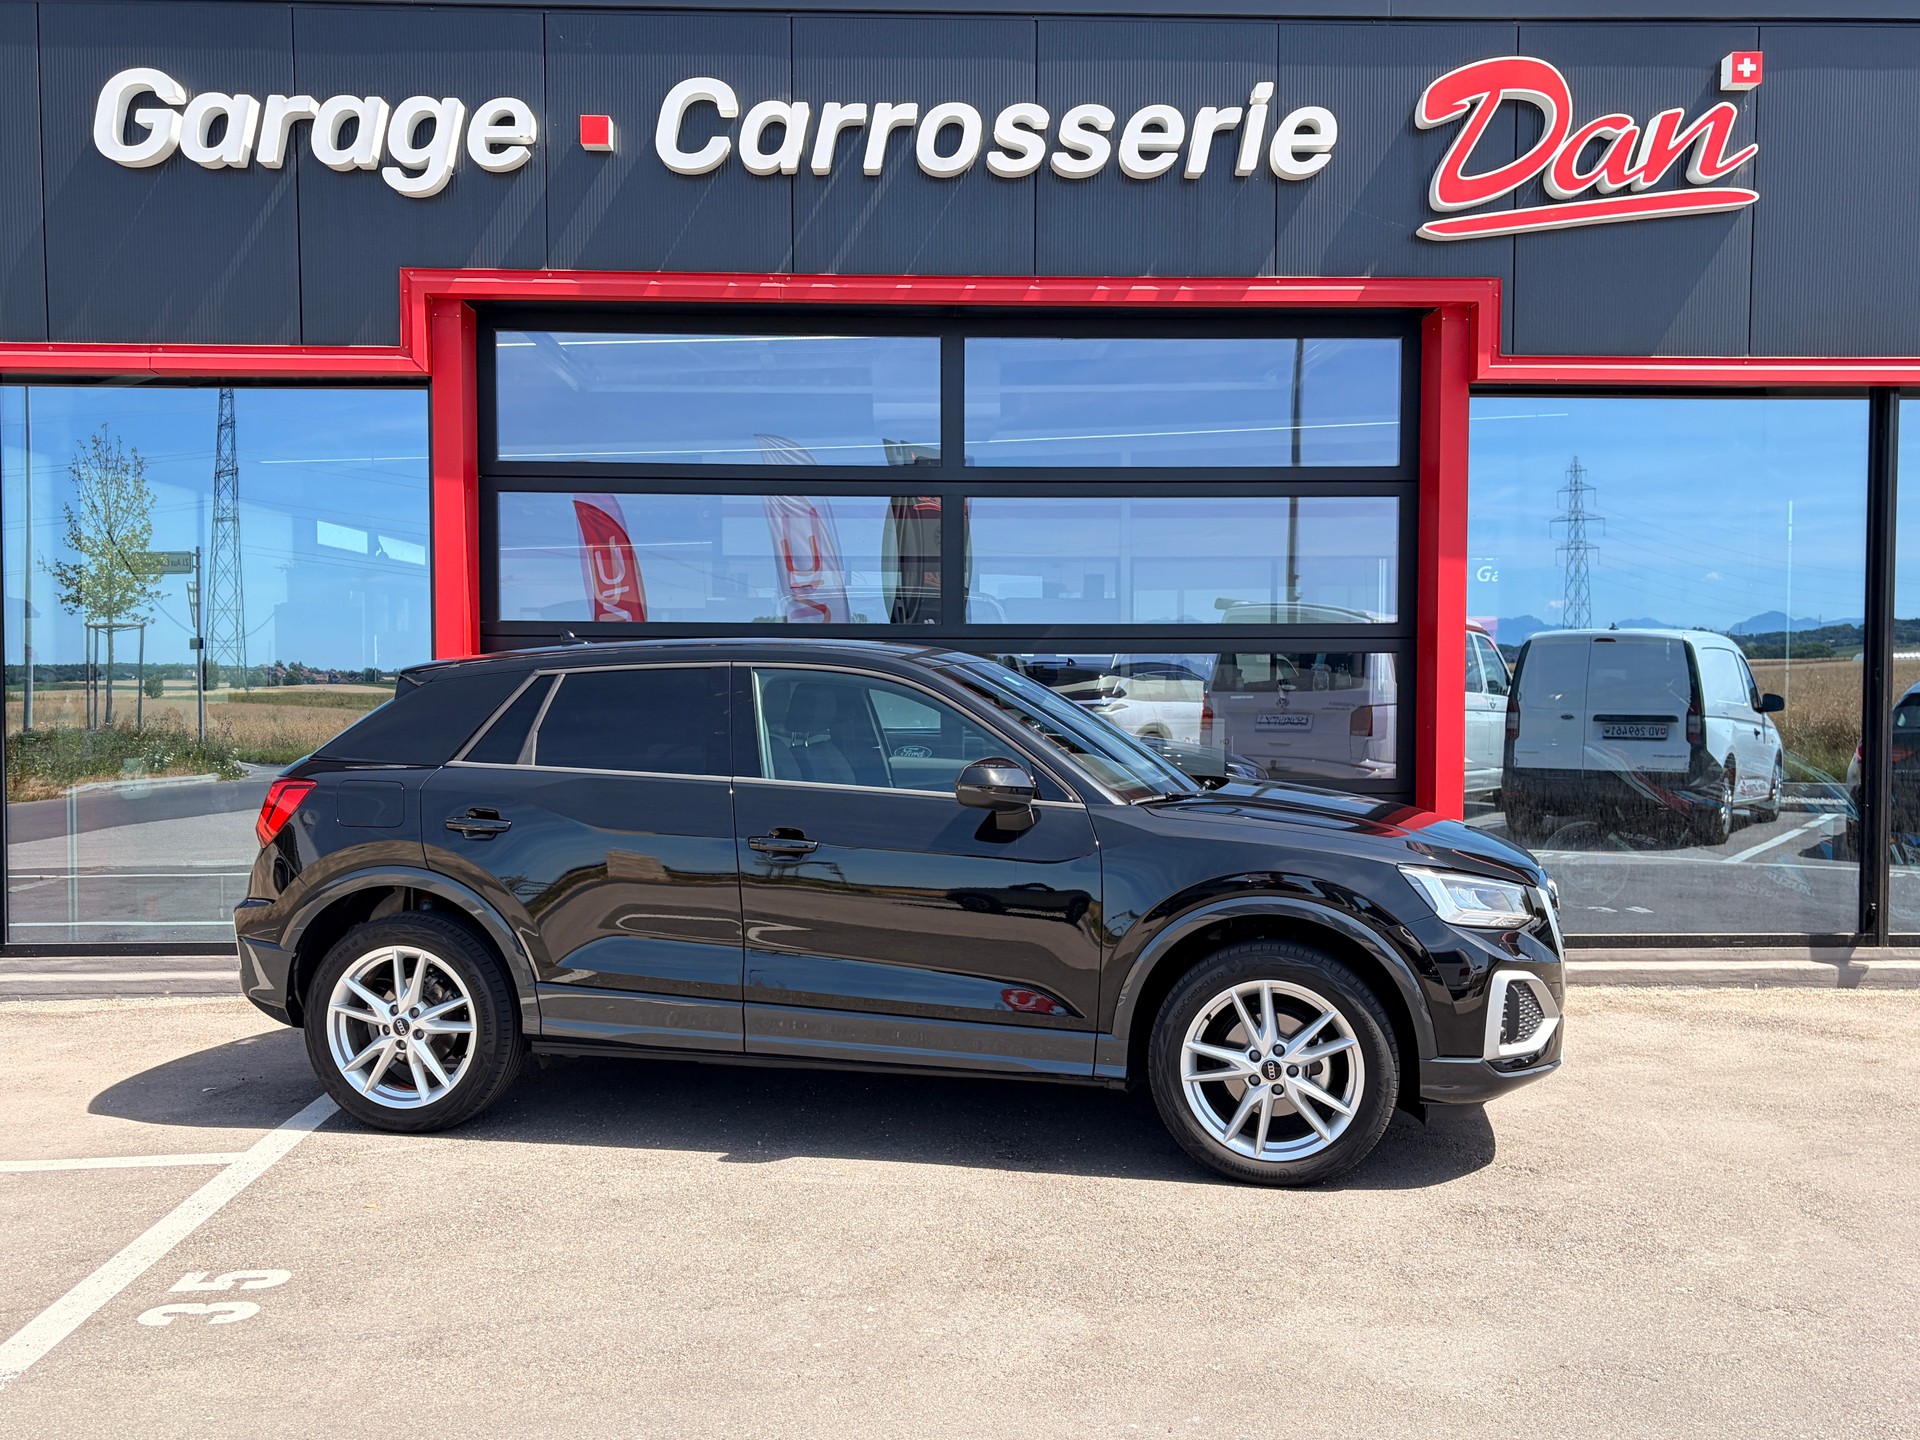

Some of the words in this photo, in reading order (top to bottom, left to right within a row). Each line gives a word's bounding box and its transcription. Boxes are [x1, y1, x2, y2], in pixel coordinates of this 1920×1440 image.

[93, 67, 538, 199] Garage
[655, 77, 1338, 181] Carrosserie
[1415, 55, 1760, 212] Dan
[1217, 1157, 1292, 1183] Continental
[136, 1269, 293, 1326] 35
